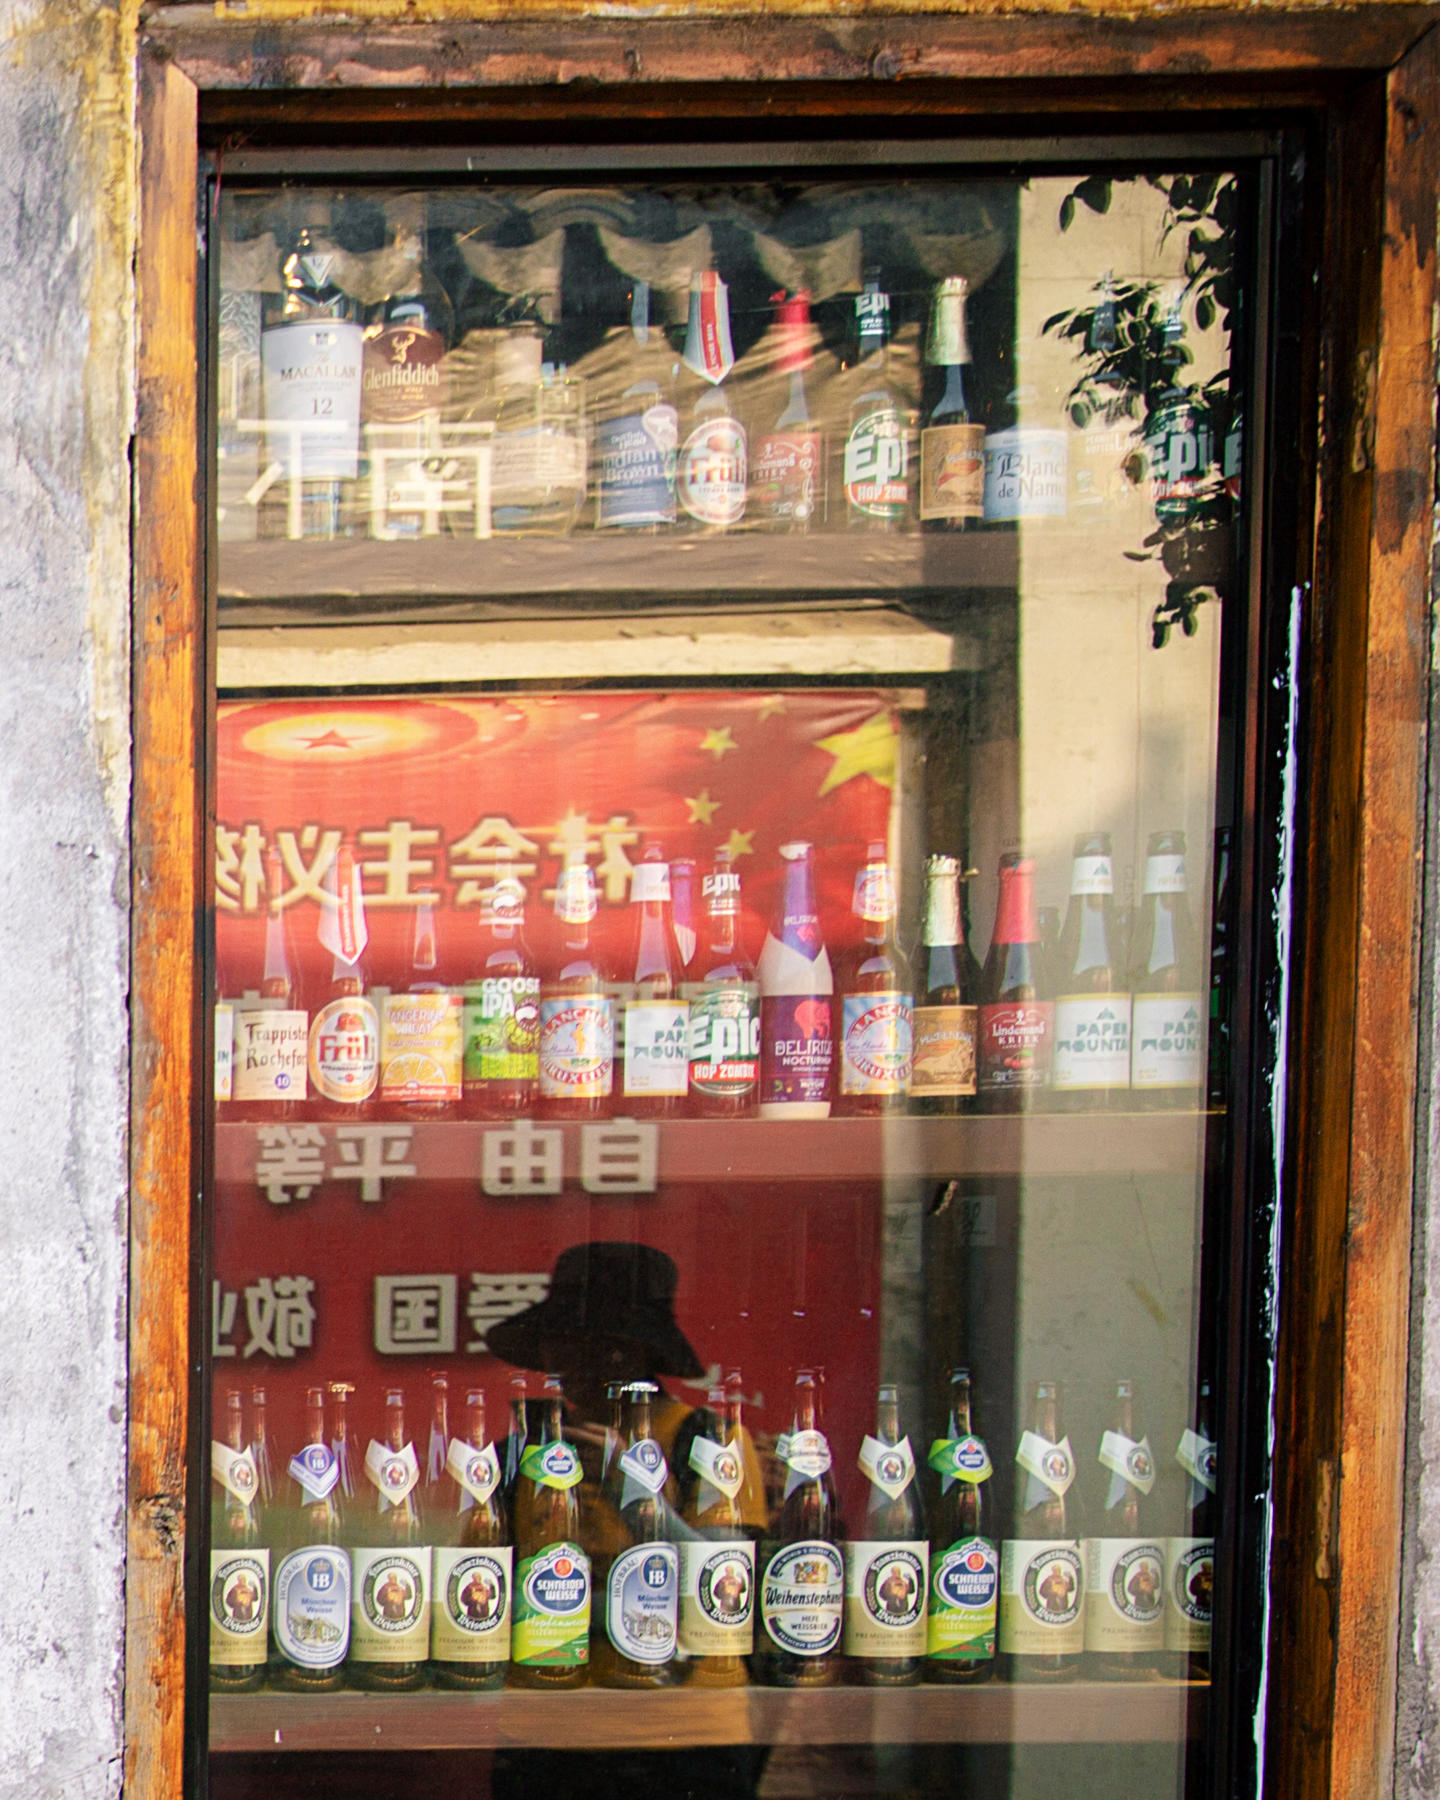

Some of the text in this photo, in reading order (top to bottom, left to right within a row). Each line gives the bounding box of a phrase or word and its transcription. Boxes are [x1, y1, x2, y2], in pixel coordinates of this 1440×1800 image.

[281, 366, 356, 381] MACALLAN
[363, 362, 439, 390] Glenfiddich
[312, 398, 333, 415] 12
[844, 429, 908, 490] Epi
[482, 993, 516, 1017] IPA
[690, 1009, 761, 1064] Epic
[992, 1020, 1044, 1037] Lindemans
[318, 1035, 375, 1062] Früli
[998, 1035, 1040, 1046] KRIEK
[246, 1048, 308, 1071] Rochefor
[694, 1063, 756, 1079] HOP ZOMBIE
[312, 1573, 329, 1590] HB
[537, 1578, 584, 1591] SCHNEIDER
[648, 1570, 665, 1585] HB
[544, 1589, 578, 1601] WEISSE
